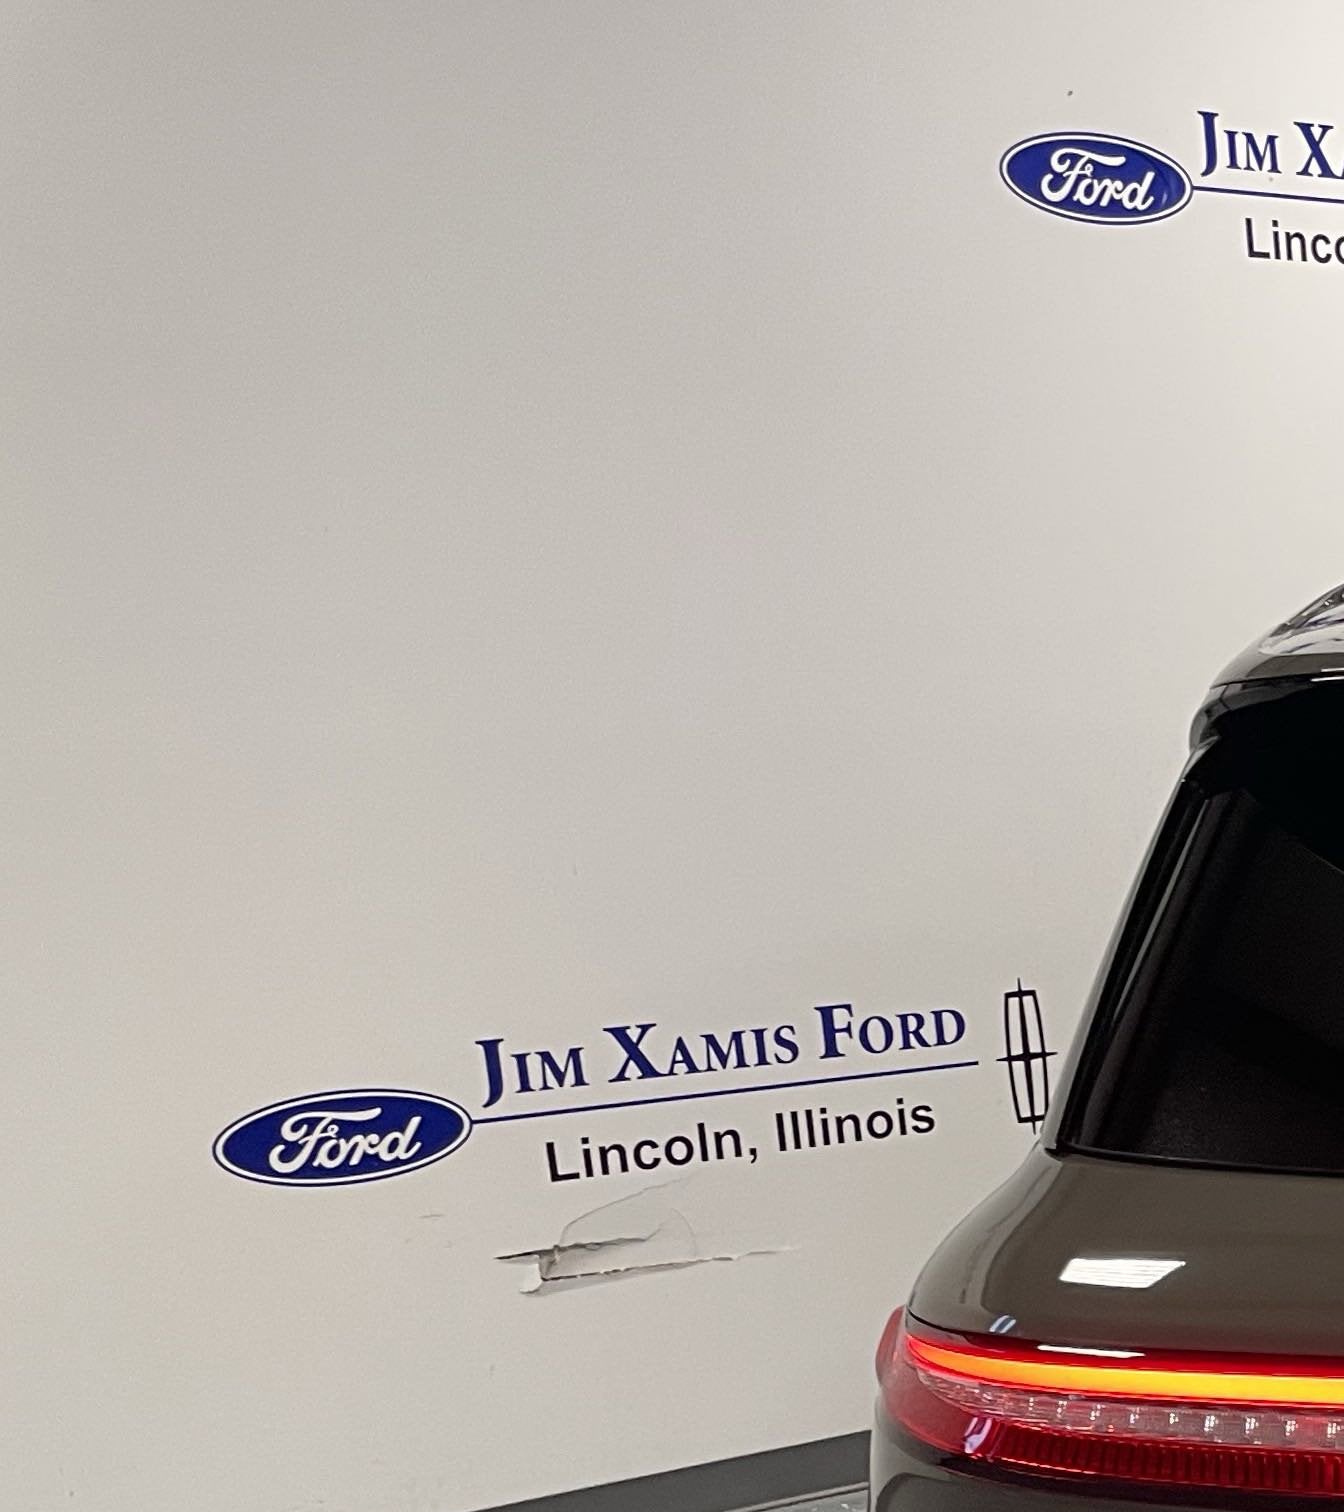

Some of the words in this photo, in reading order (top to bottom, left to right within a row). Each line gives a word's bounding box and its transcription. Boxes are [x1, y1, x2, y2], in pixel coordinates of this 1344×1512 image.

[1197, 111, 1281, 176] JIM
[1040, 148, 1155, 210] Ford
[475, 1038, 585, 1108] JIM
[603, 1022, 800, 1084] XAMIS
[814, 1003, 966, 1061] FORD
[268, 1106, 423, 1172] Ford
[545, 1121, 758, 1183] Lincoln,
[774, 1097, 937, 1154] Illinois
